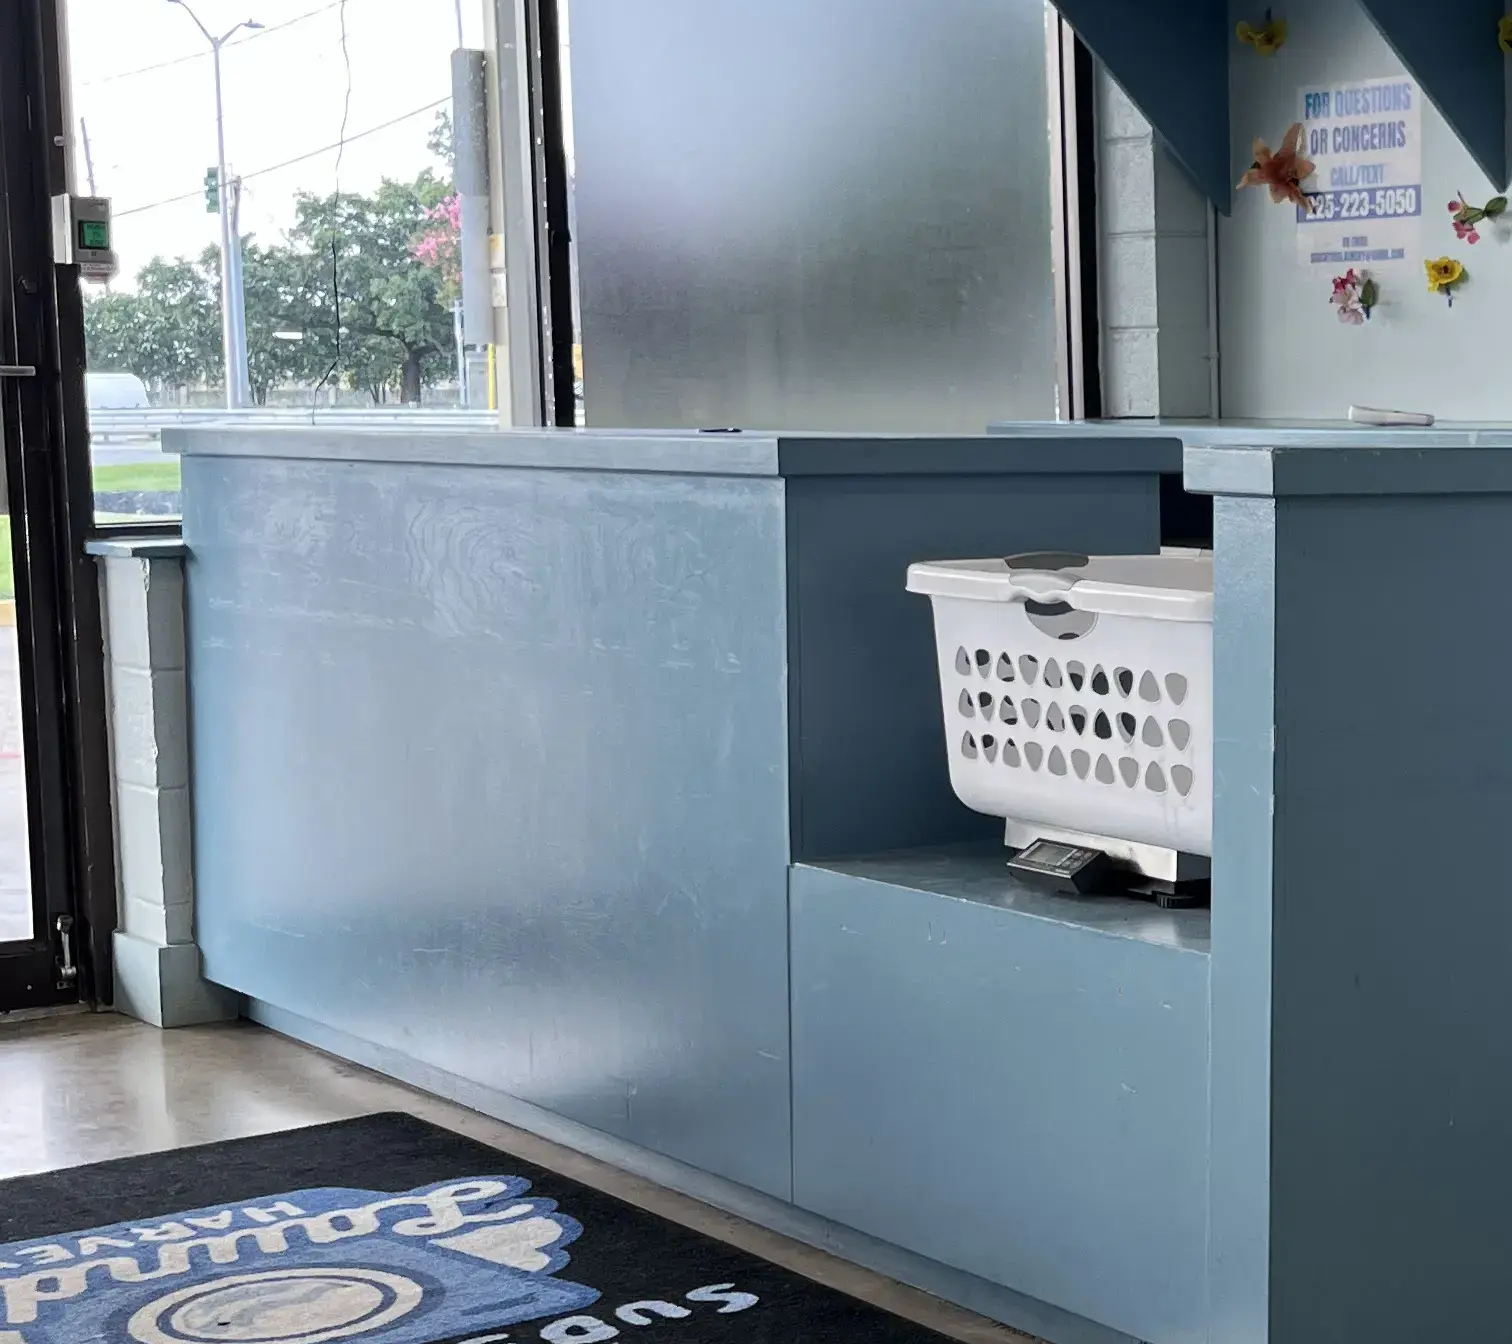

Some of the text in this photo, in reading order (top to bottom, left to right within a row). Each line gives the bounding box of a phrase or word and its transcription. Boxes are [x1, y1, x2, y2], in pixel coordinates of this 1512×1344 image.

[1305, 82, 1412, 120] FOR QUESTIONS
[1310, 120, 1406, 155] OR CONCERNS
